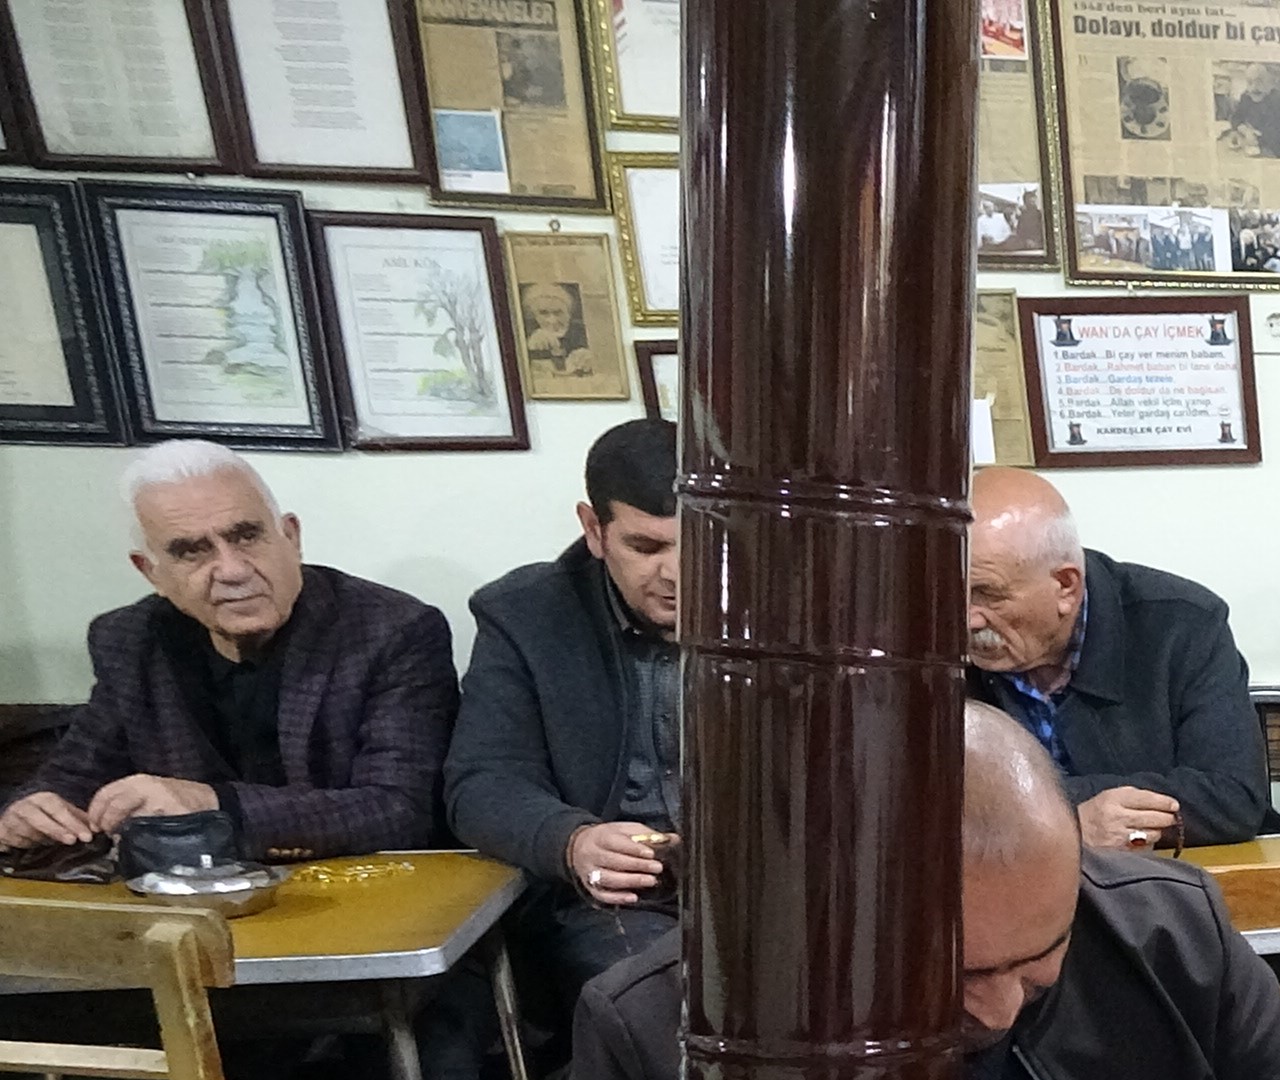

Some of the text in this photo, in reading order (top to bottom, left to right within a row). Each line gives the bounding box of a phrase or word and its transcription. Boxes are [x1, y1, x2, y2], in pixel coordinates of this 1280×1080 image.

[1151, 18, 1221, 39] doldur
[1225, 20, 1246, 40] bi
[1134, 325, 1160, 341] ÇAY
[1163, 324, 1205, 341] İÇMEK
